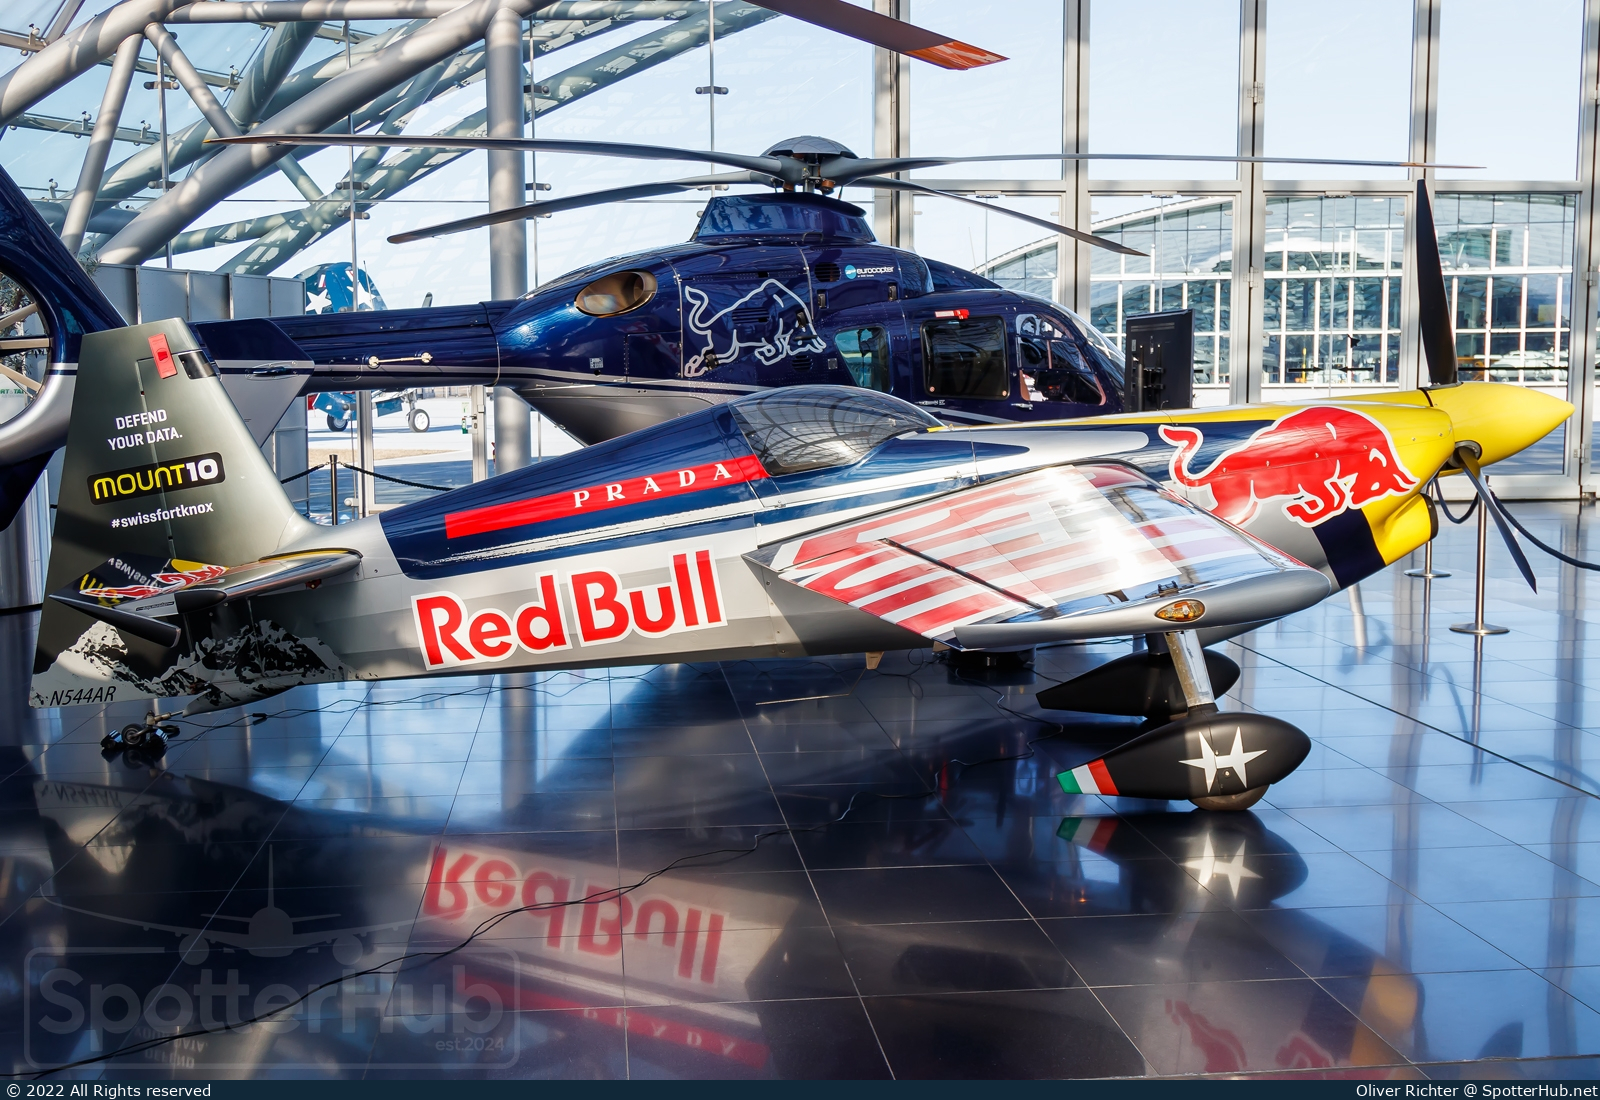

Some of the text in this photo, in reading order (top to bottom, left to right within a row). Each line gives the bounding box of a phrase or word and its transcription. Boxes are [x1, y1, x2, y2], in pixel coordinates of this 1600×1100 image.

[856, 266, 894, 274] eurocopter
[115, 409, 168, 430] DEFEND
[107, 426, 183, 451] YOUR DATA.
[573, 463, 732, 508] PRADA
[111, 502, 214, 529] #swissfortknox
[415, 573, 568, 666] Red
[571, 549, 723, 643] Bull
[49, 685, 117, 706] N544AR
